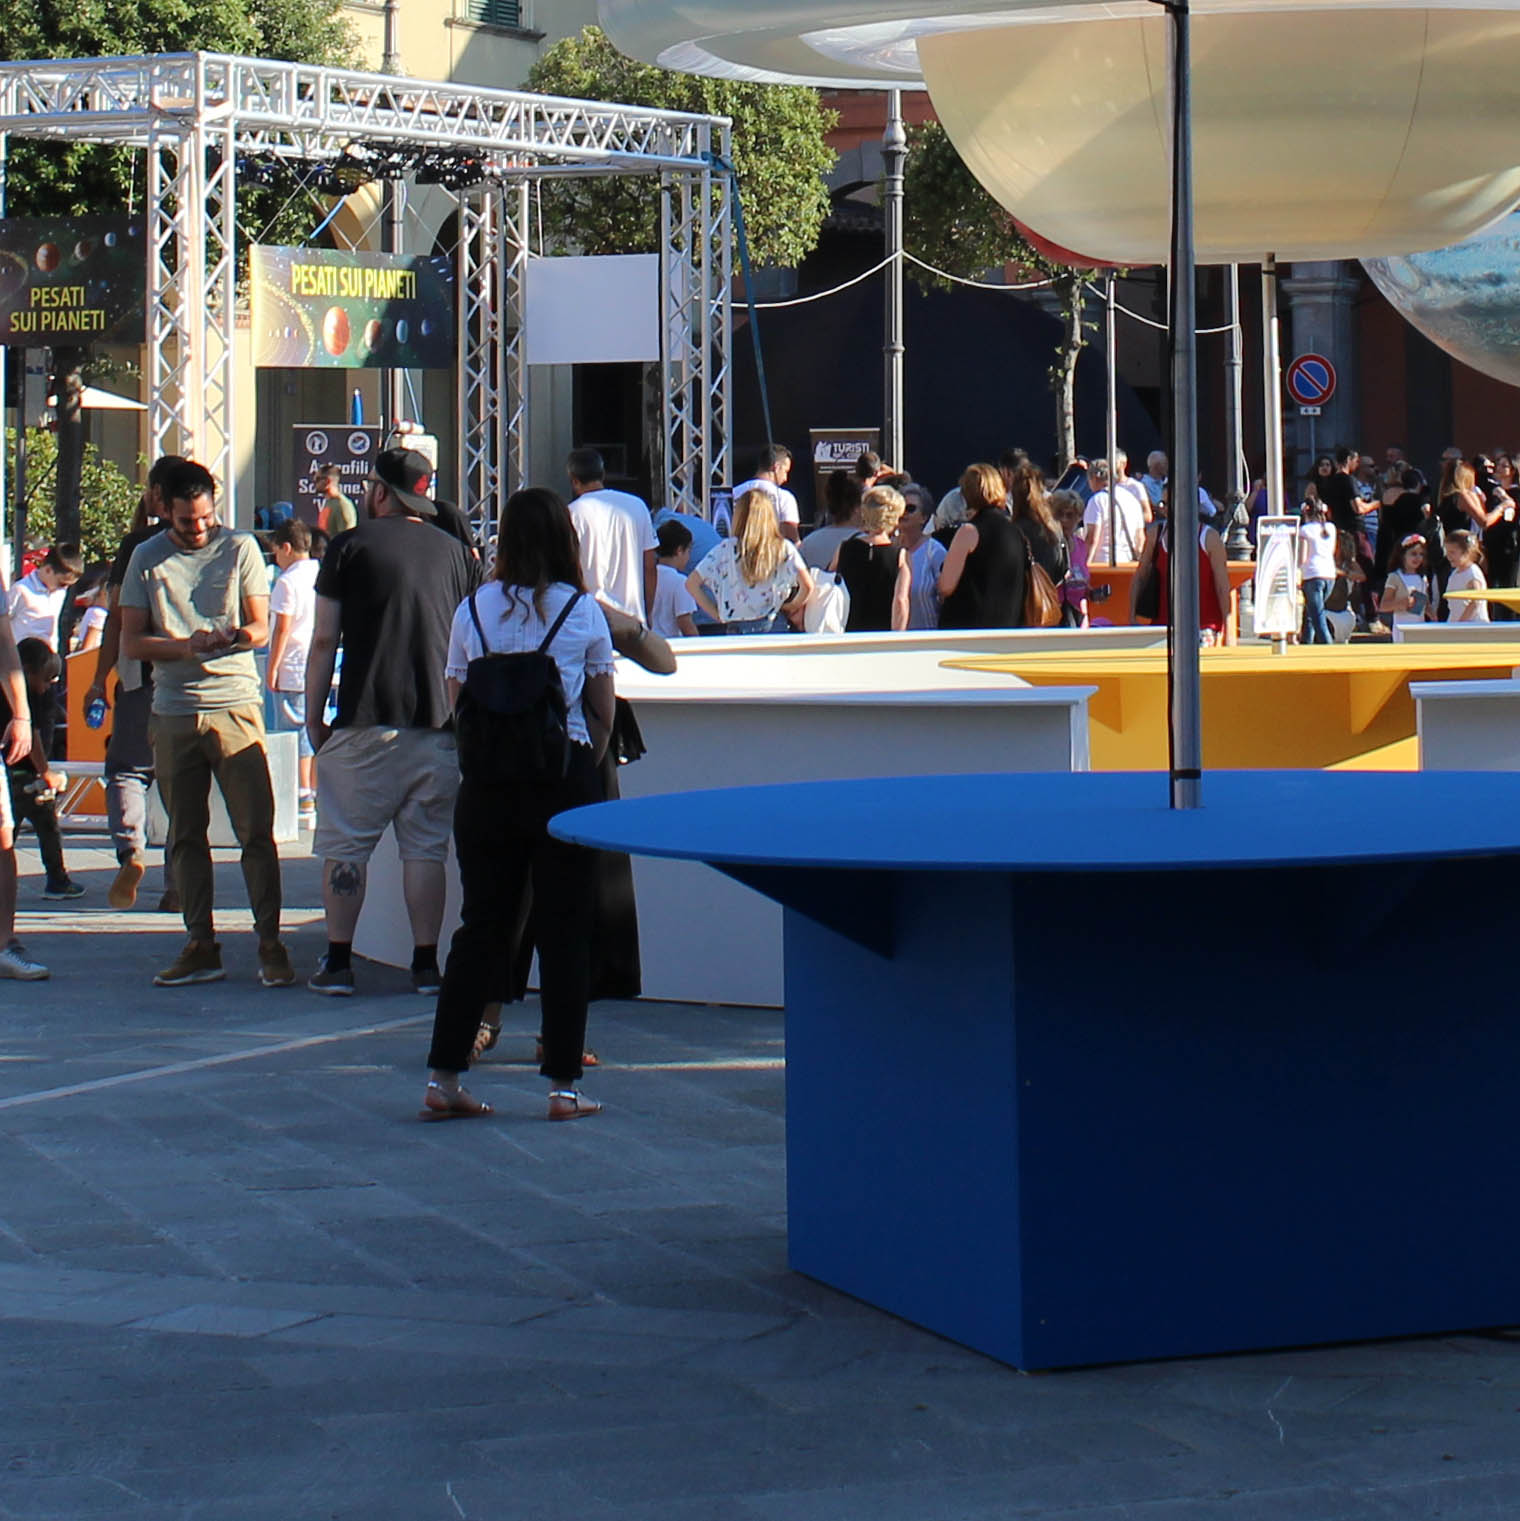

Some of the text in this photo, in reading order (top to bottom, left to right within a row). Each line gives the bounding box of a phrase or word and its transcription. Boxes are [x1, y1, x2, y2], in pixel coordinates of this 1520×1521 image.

[292, 263, 417, 300] PESATI SUI PIANETI
[30, 286, 85, 308] PESATI
[9, 309, 105, 333] SUI PIANETI
